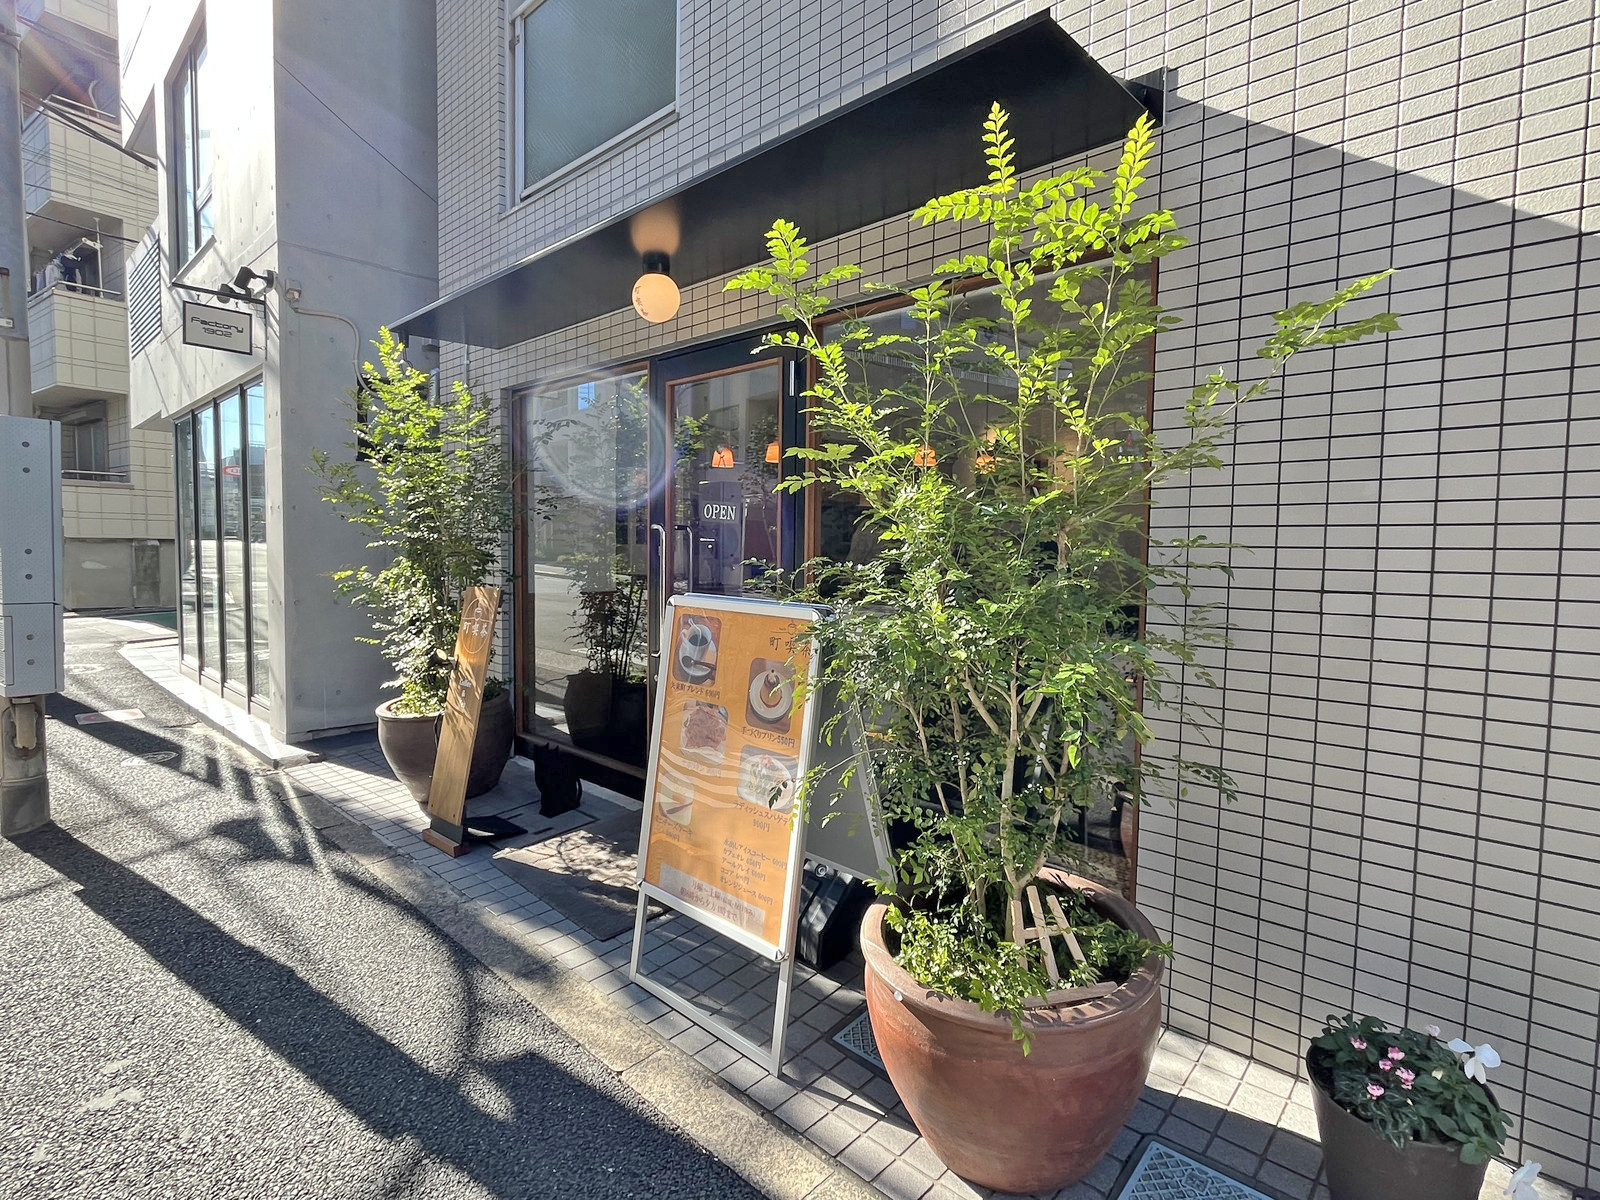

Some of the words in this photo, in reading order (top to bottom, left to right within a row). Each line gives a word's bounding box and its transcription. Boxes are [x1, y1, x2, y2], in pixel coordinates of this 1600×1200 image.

[190, 316, 244, 334] Factory
[202, 326, 233, 339] 1902
[703, 503, 737, 521] OPEN
